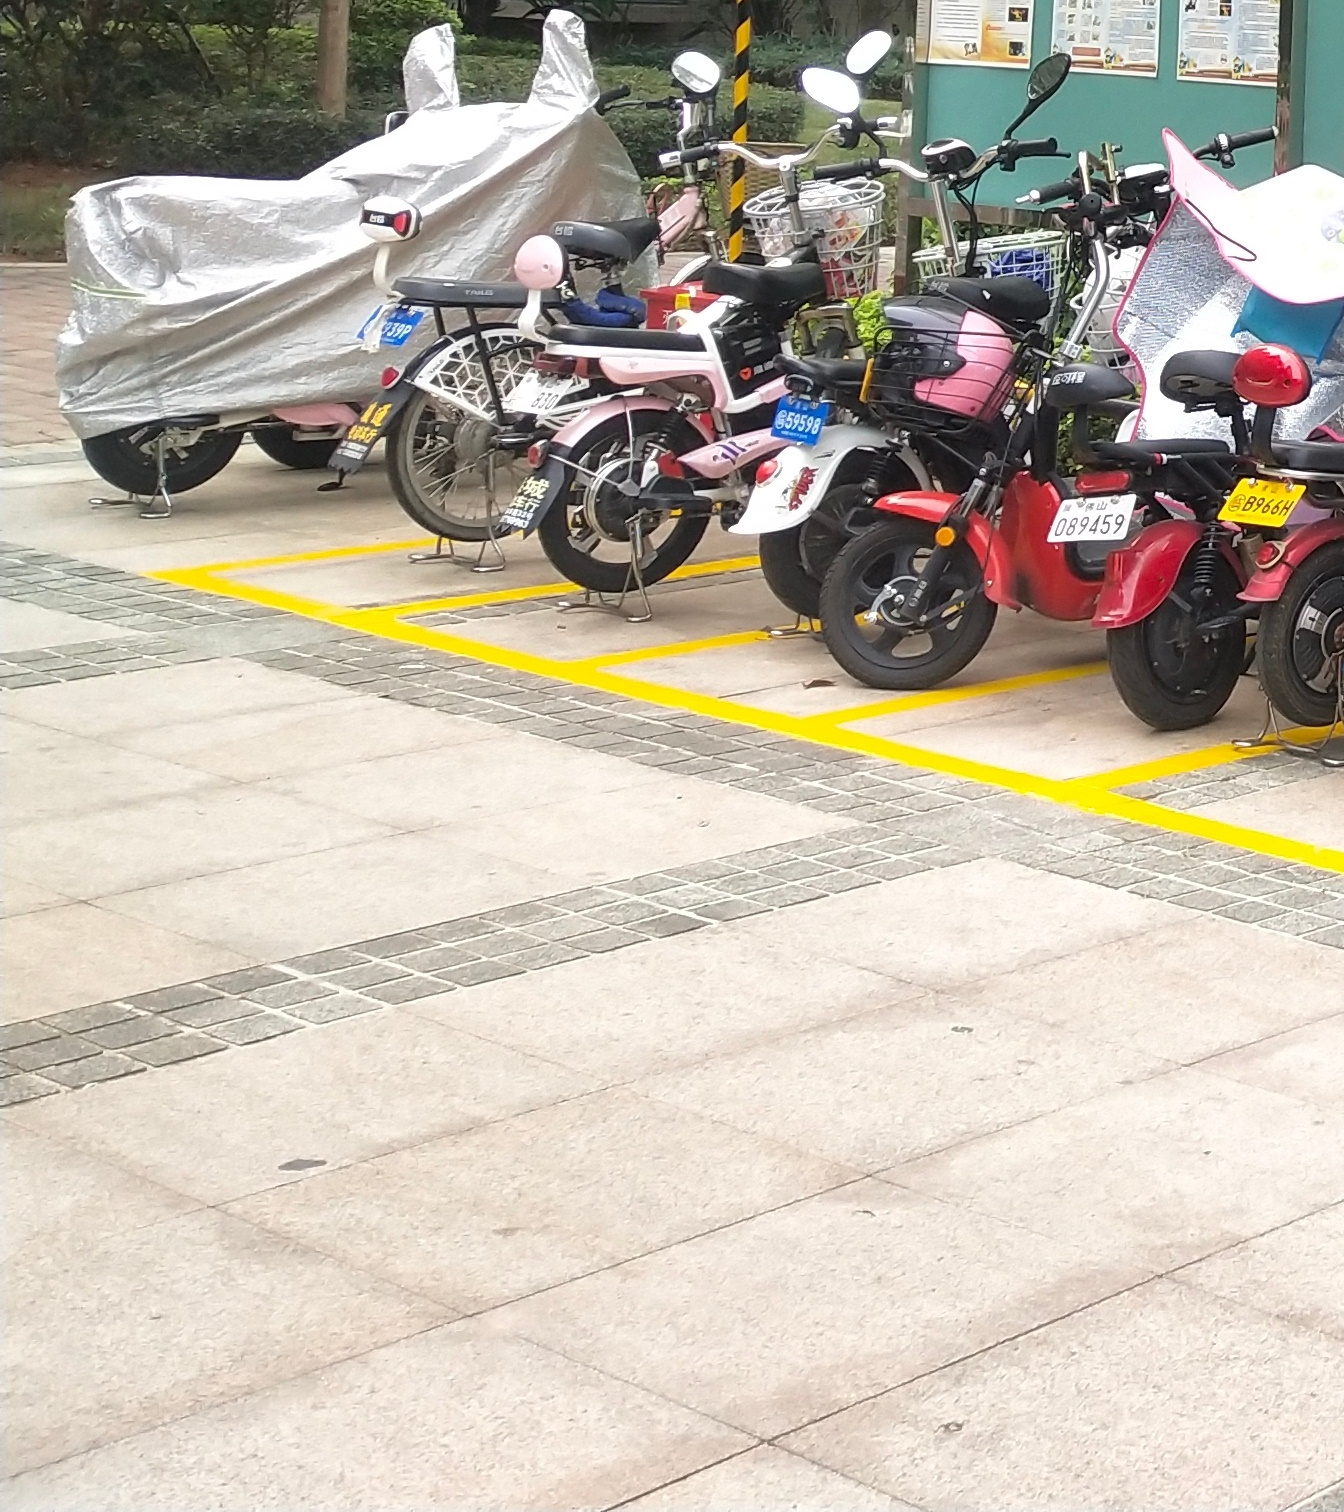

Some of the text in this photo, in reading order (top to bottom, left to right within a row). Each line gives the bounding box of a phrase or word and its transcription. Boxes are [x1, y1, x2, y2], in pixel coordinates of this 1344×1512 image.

[379, 322, 413, 342] 939P
[1084, 500, 1109, 512] 佛山
[1054, 513, 1125, 537] 089459
